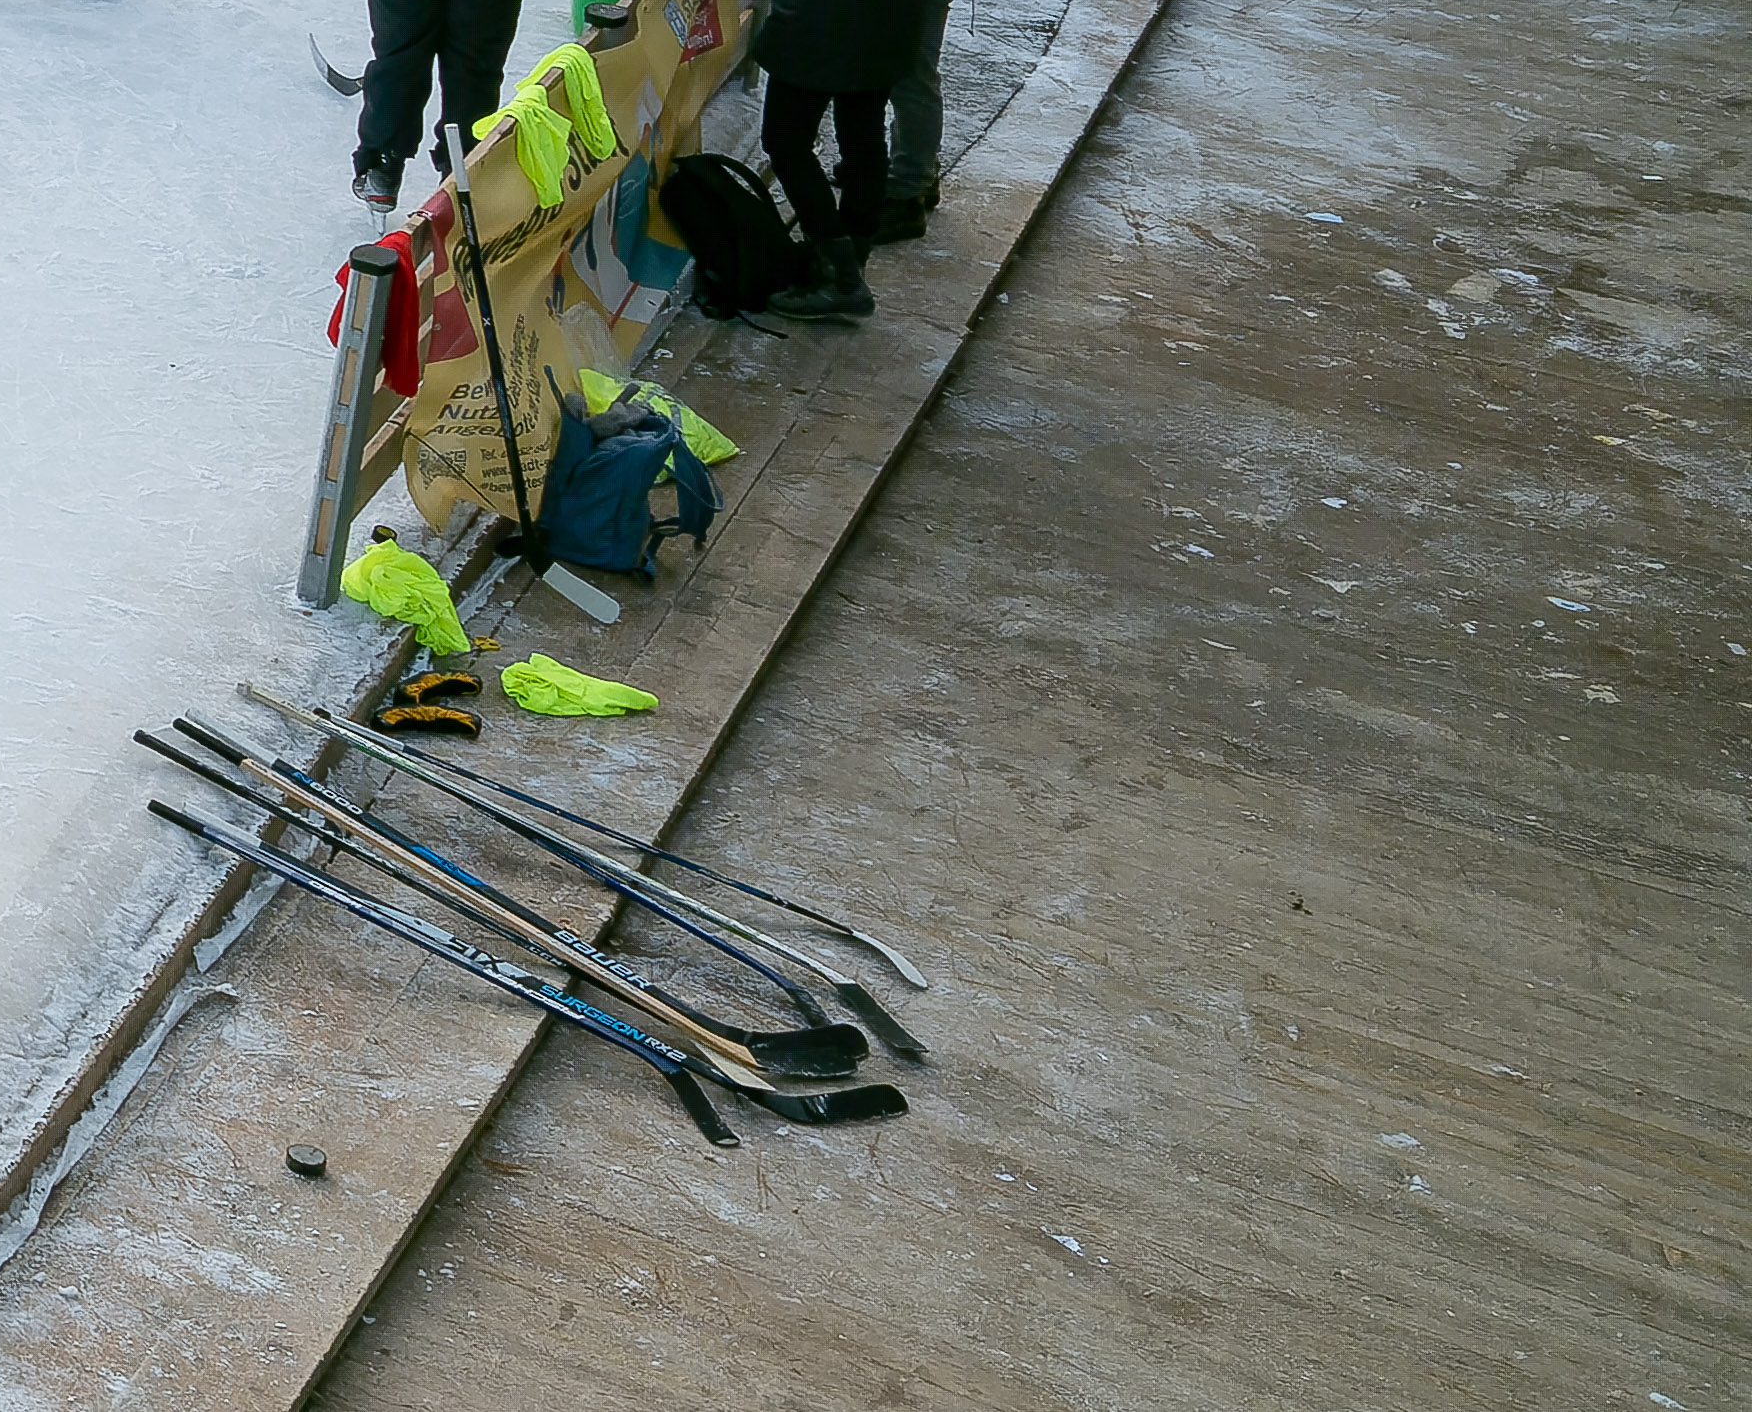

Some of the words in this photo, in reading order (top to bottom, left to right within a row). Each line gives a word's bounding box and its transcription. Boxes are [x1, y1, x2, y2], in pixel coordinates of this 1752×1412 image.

[438, 403, 501, 421] Nutz
[552, 927, 655, 992] BAUER
[539, 983, 647, 1042] SURGEON
[644, 1036, 688, 1063] RX2
